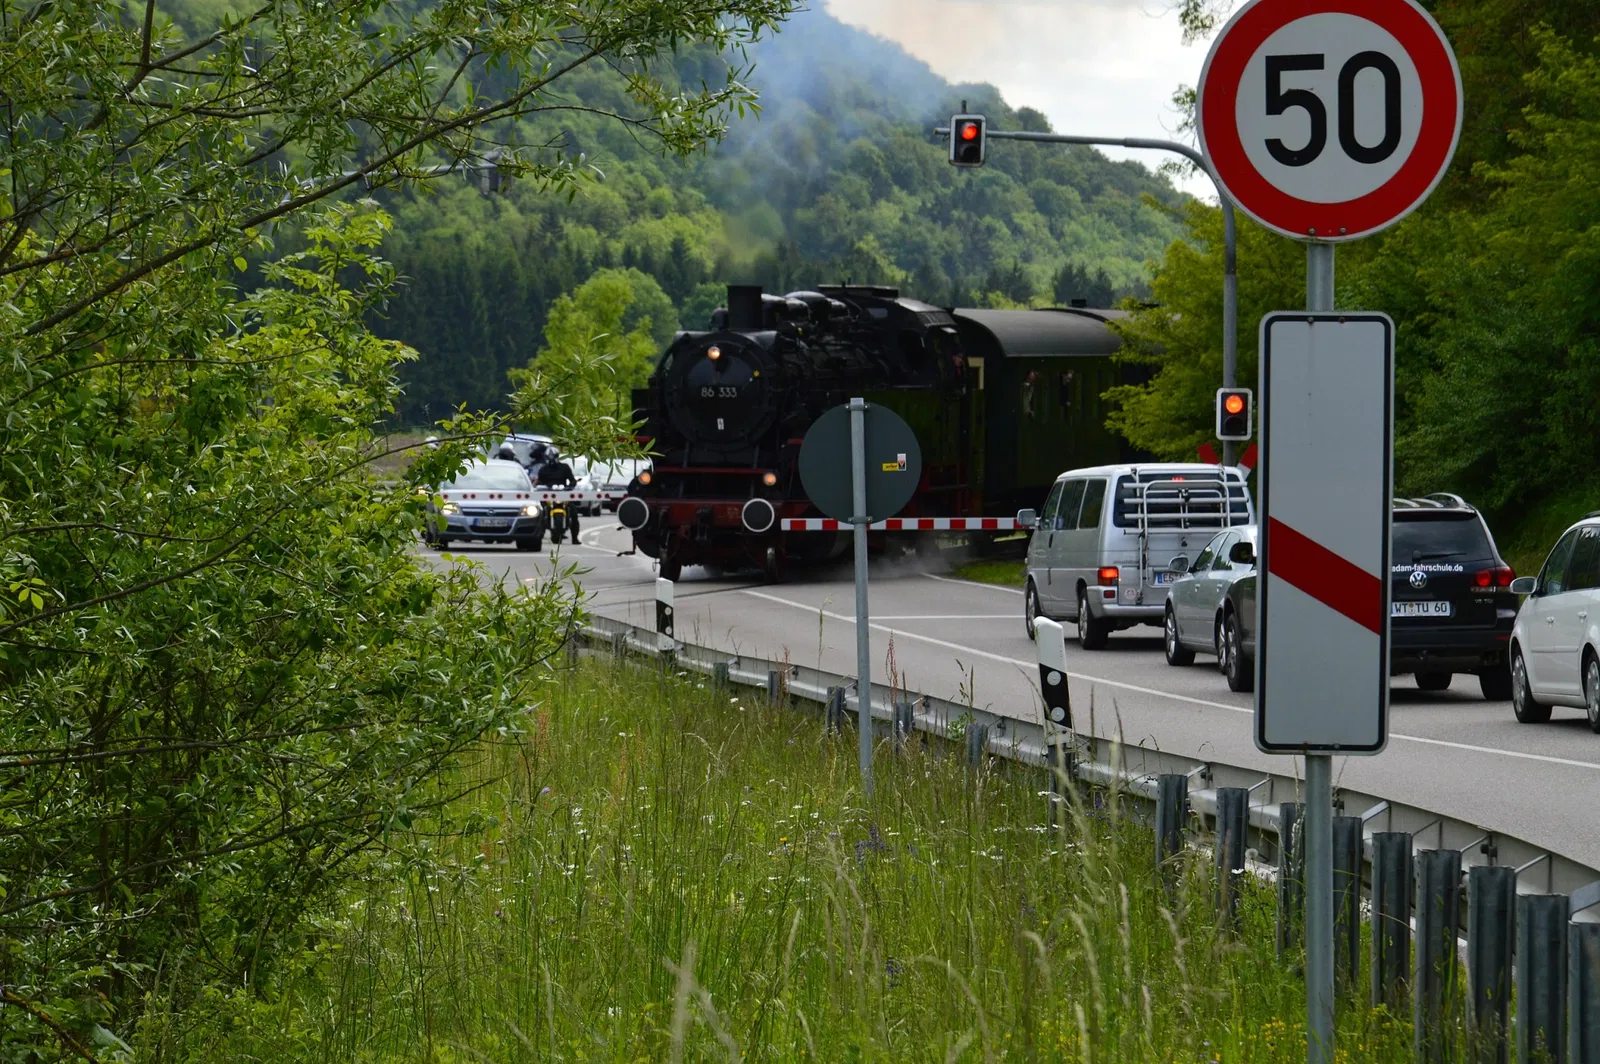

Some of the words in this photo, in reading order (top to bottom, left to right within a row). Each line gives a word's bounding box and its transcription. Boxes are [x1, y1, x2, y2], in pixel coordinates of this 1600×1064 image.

[1264, 51, 1401, 167] 50
[701, 386, 715, 398] 86
[719, 387, 737, 398] 333
[1391, 564, 1463, 572] adam-fahrschule.de
[1394, 603, 1408, 613] WT
[1416, 602, 1429, 613] TU
[1434, 602, 1448, 613] 60
